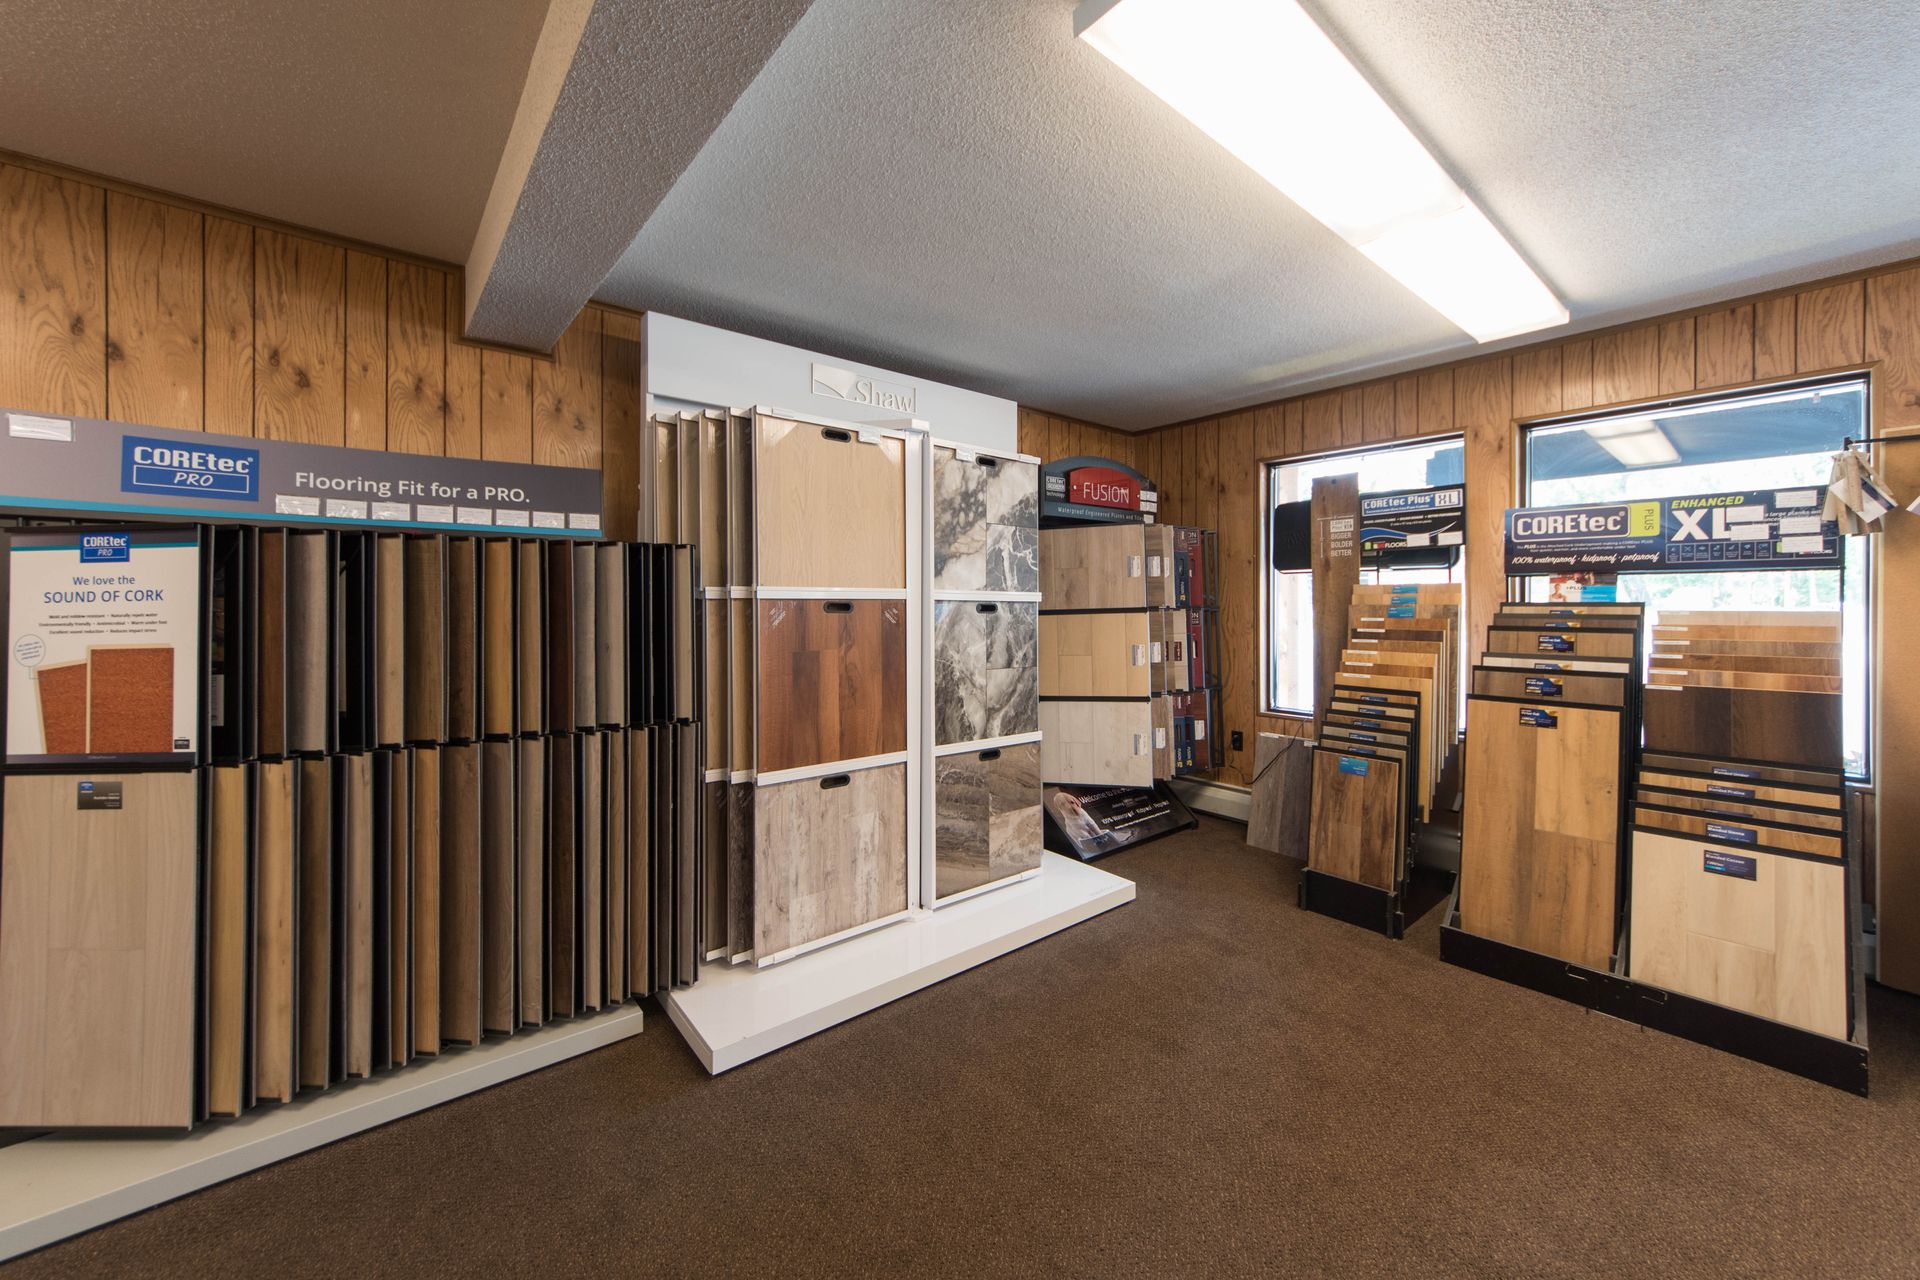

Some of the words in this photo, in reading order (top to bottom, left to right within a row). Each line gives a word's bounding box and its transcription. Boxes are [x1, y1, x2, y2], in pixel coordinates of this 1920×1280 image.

[856, 380, 912, 412] Shaw
[174, 472, 213, 487] PRO
[295, 472, 392, 497] Flooring
[398, 480, 425, 496] Fit
[431, 482, 461, 499] for
[467, 488, 478, 500] a
[484, 486, 530, 503] PRO.
[1083, 482, 1130, 504] FUSION
[1364, 499, 1405, 509] COREtec
[1408, 495, 1430, 504] Plus
[1671, 495, 1745, 509] ENHANCED
[1057, 507, 1084, 515] Waterproof
[1085, 509, 1110, 517] Engineered
[1517, 514, 1621, 536] COREtec
[1644, 509, 1654, 531] PLUS
[1671, 508, 1731, 541] XL
[1331, 532, 1351, 540] BIGGER
[97, 548, 113, 557] PRO
[1512, 556, 1533, 564] 100%
[1534, 555, 1577, 565] waterproof
[1581, 553, 1617, 563] kidproof
[1621, 552, 1660, 563] petproof
[72, 576, 90, 585] We
[92, 575, 115, 585] love
[118, 575, 136, 585] the
[44, 591, 96, 604] SOUND
[101, 590, 120, 602] OF
[124, 589, 164, 602] CORK
[1079, 792, 1107, 804] Welcome
